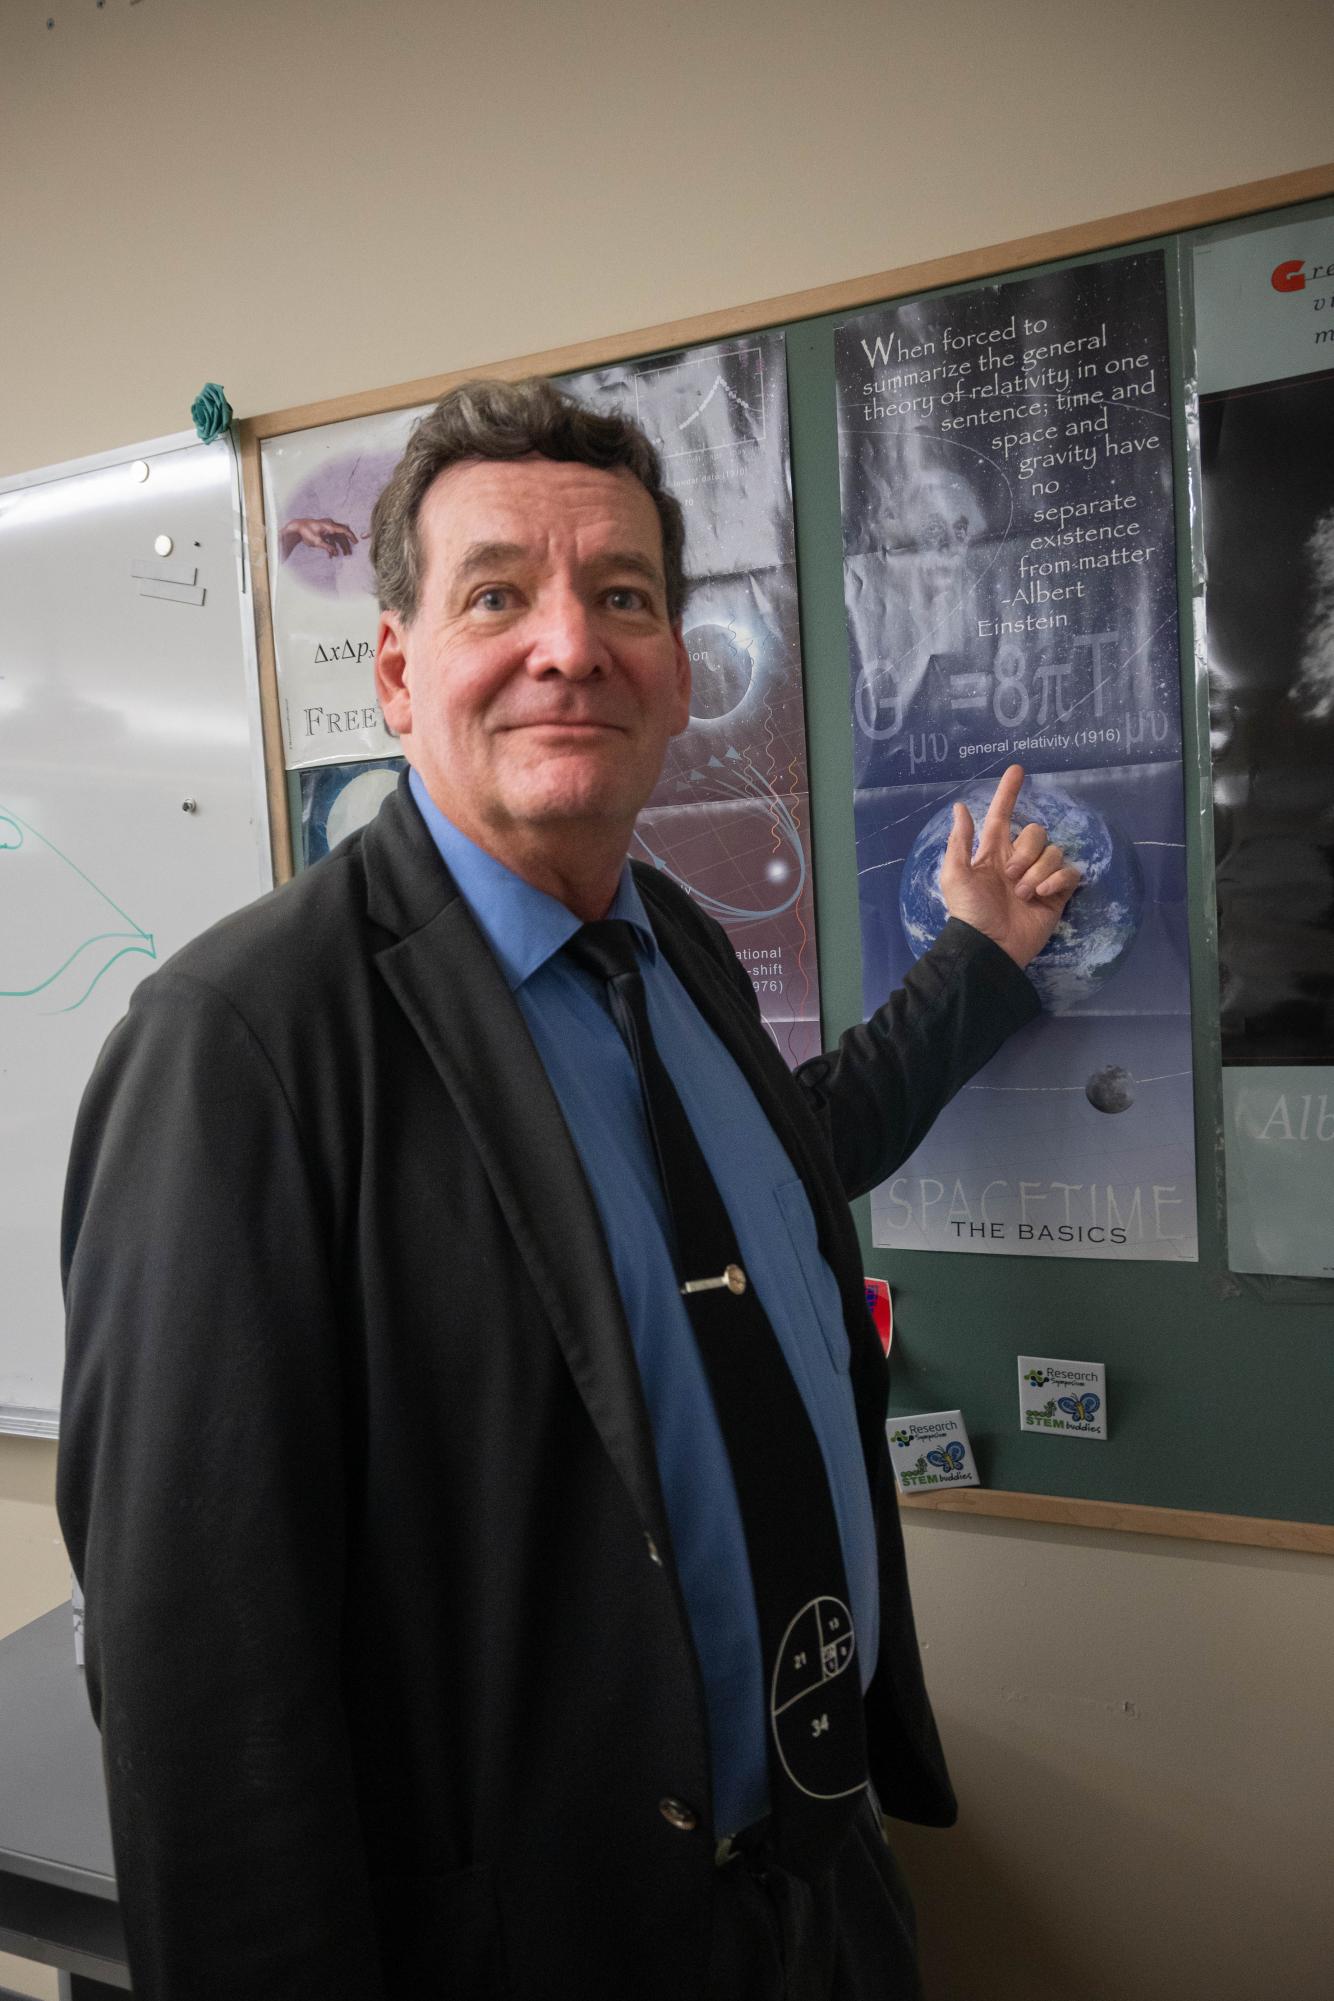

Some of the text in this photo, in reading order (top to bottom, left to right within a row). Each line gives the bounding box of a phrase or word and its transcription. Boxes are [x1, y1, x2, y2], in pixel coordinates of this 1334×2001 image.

[860, 316, 1048, 368] When forced to
[863, 323, 1107, 395] summarize the general
[864, 354, 1149, 421] theory of relativity in one
[941, 369, 1156, 432] sentence; time and
[992, 406, 1108, 458] space and
[1018, 433, 1160, 479] gravity have
[1032, 481, 1060, 496] no
[1033, 494, 1137, 529] separate
[1030, 522, 1141, 550] existence
[1018, 547, 1156, 578] from matter
[1001, 580, 1087, 606] -Albert
[977, 611, 1068, 637] Einstein
[303, 706, 377, 737] FREE
[958, 728, 1121, 758] general relativity (1916)
[950, 1221, 1129, 1245] THE BASICS
[1046, 1367, 1099, 1382] Research
[909, 1420, 958, 1435] Research
[1025, 1416, 1102, 1434] STEM buddies
[901, 1472, 973, 1487] STEM buddies
[811, 1712, 830, 1738] 34
